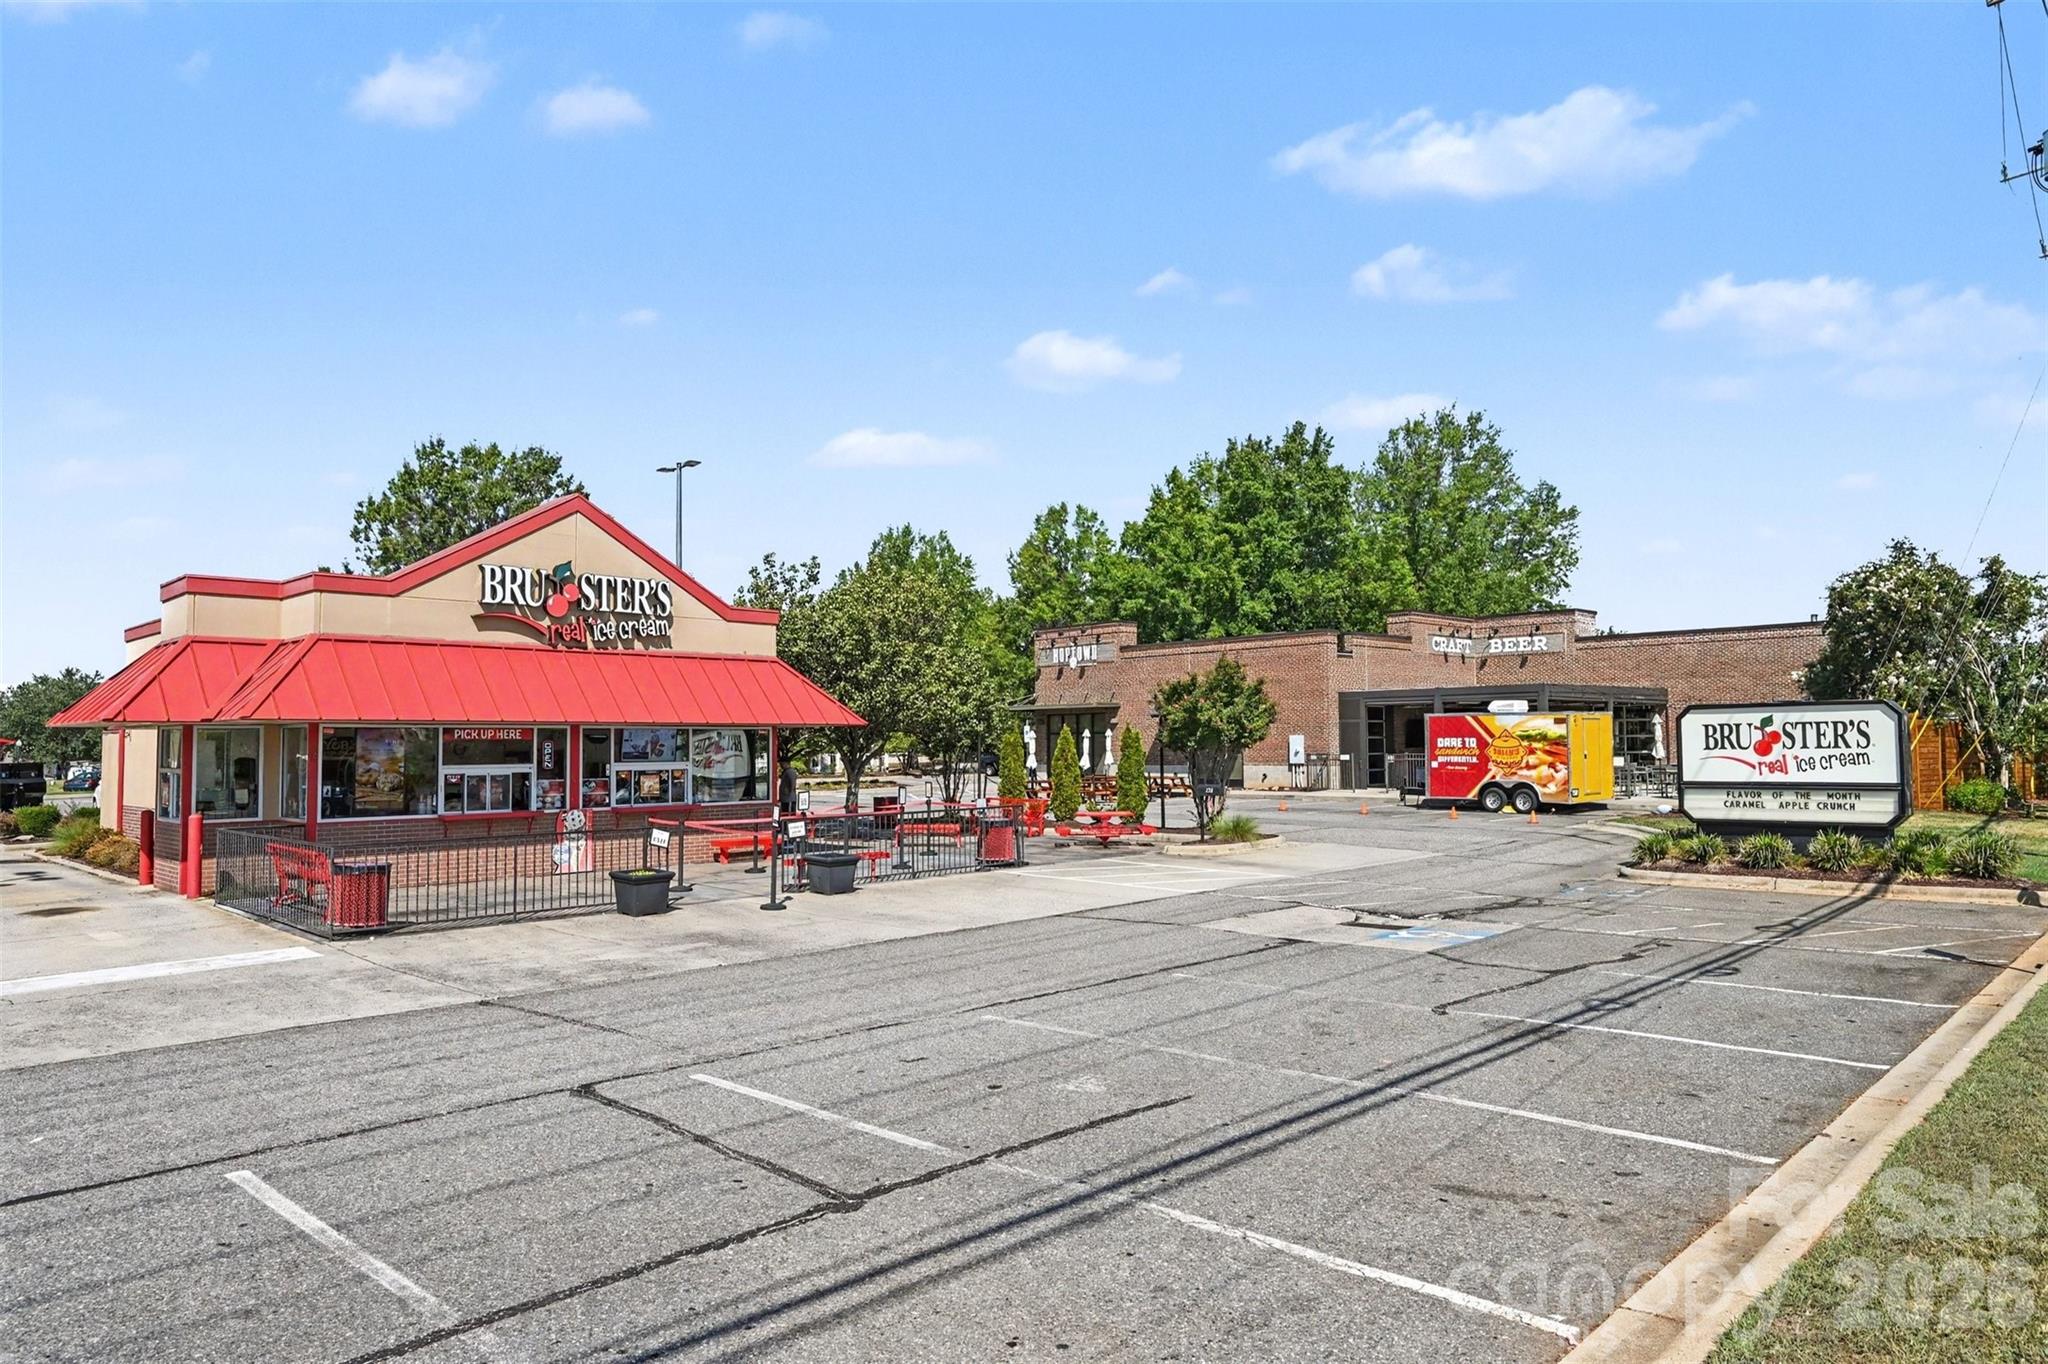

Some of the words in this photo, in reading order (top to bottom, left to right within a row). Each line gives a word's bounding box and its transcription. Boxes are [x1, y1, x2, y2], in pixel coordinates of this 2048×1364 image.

[481, 563, 671, 617] BRUSTER'S
[550, 617, 586, 643] real
[591, 619, 616, 642] ice
[618, 618, 670, 640] cream
[1432, 636, 1472, 653] CRAFT
[1488, 636, 1548, 653] BEER
[454, 729, 479, 739] PICK
[480, 729, 495, 739] UP
[496, 729, 522, 739] HERE
[1437, 737, 1463, 748] DARE
[1464, 737, 1477, 748] TO
[1702, 719, 1872, 751] BRUSTER'S
[544, 742, 552, 768] OPEN
[1757, 753, 1789, 776] real
[1793, 754, 1816, 772] ice
[1820, 751, 1871, 770] cream
[1723, 800, 1766, 809] CARAMEL
[1778, 801, 1810, 810] APPLE
[1817, 802, 1856, 811] CRUNCH
[1726, 790, 1762, 799] FLAVOR
[1772, 791, 1784, 799] OF
[1795, 791, 1811, 800] THE
[1826, 792, 1862, 801] MONTH
